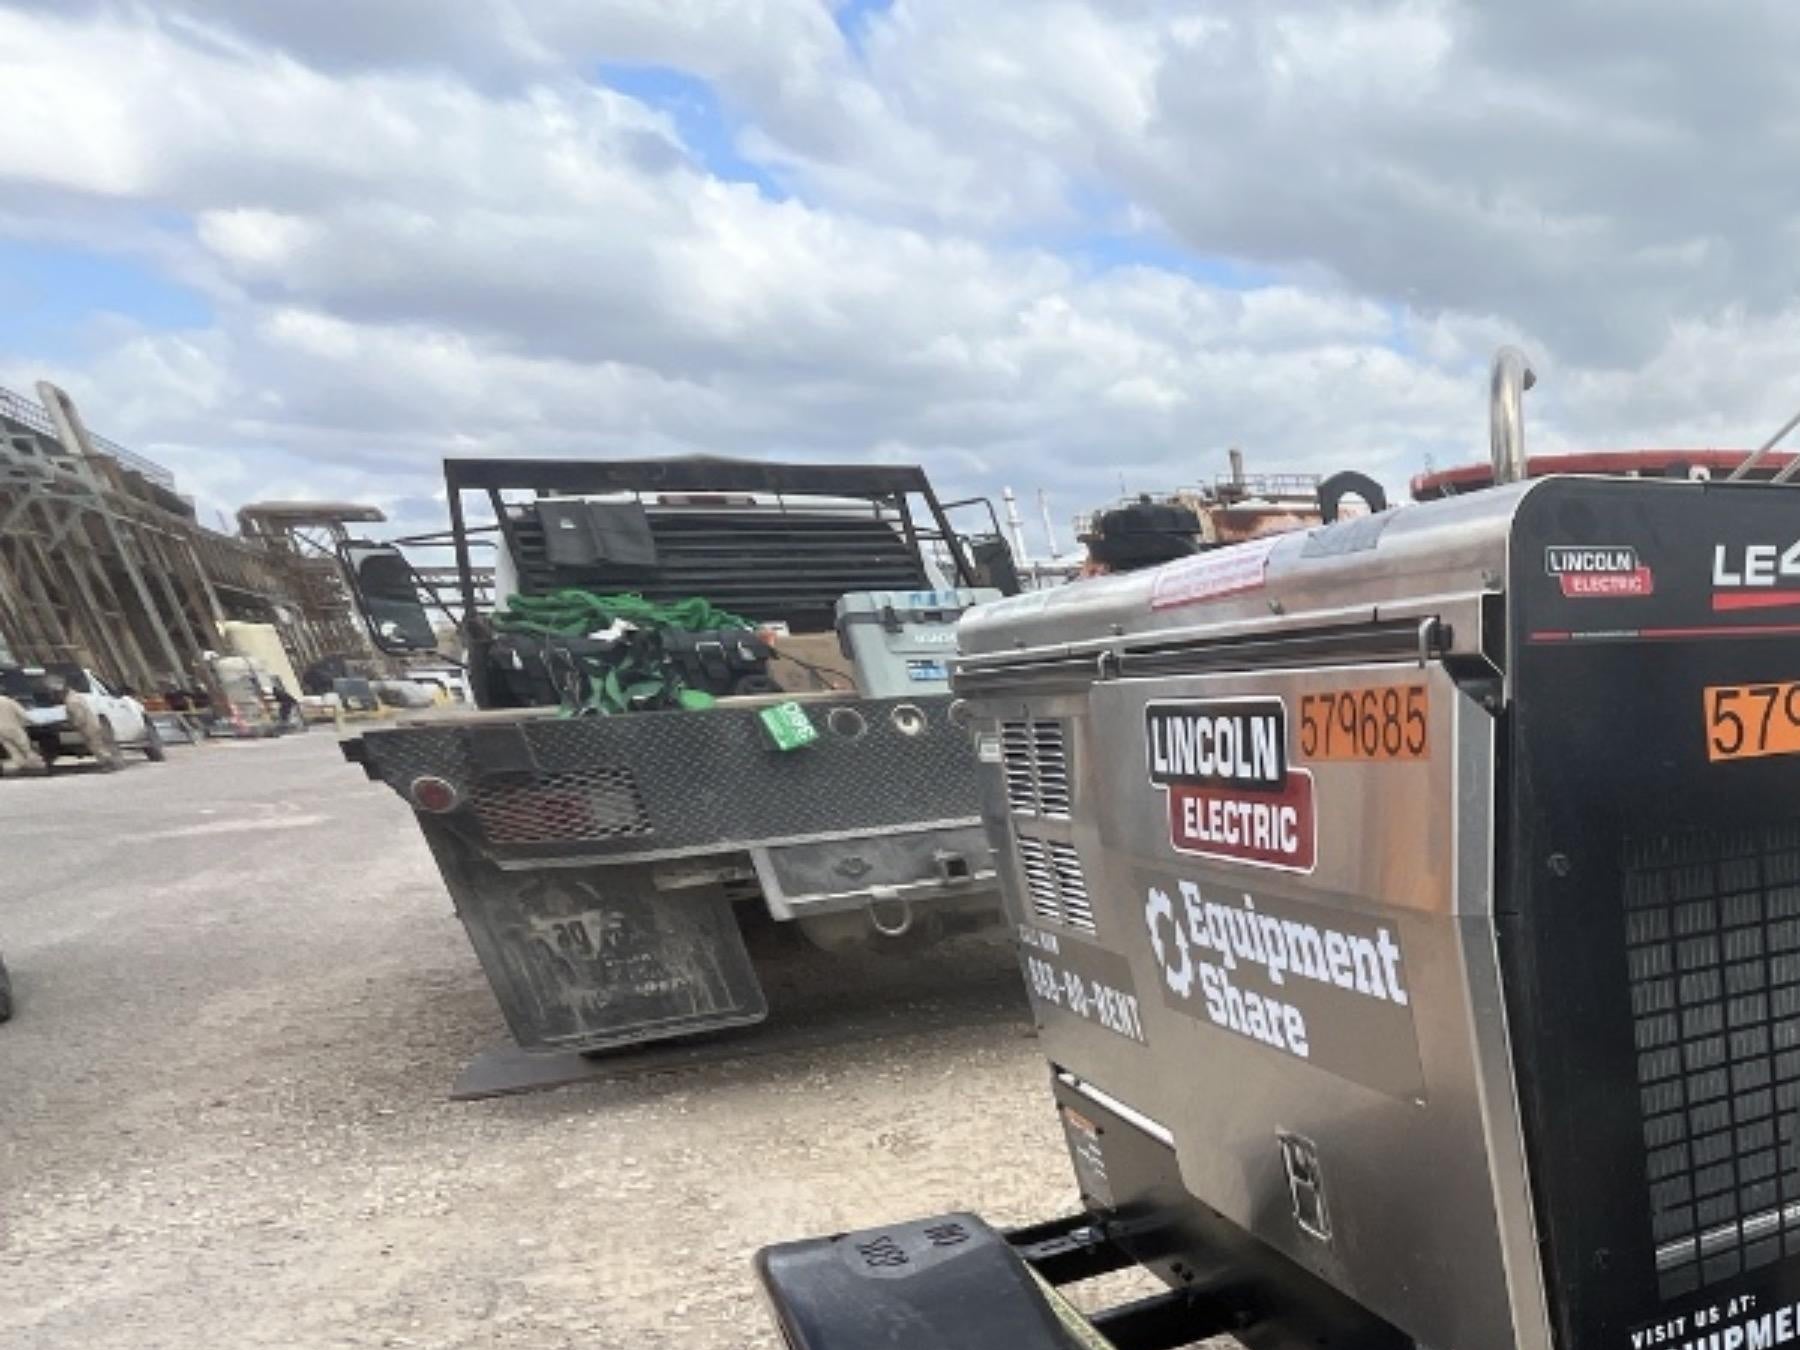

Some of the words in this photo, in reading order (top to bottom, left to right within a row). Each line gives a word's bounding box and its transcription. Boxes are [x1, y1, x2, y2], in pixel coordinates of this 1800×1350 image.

[1549, 551, 1632, 572] LINCOLN
[1573, 575, 1643, 593] ELECTRIC
[1151, 715, 1278, 781] LINCOLN
[1300, 686, 1426, 757] 579685
[1183, 797, 1298, 854] ELECTRIC
[1179, 880, 1409, 1006] Equipment
[1199, 962, 1309, 1057] Share
[1631, 1316, 1686, 1350] VISIT
[1694, 1303, 1720, 1327] US
[1727, 1294, 1757, 1318] AT:
